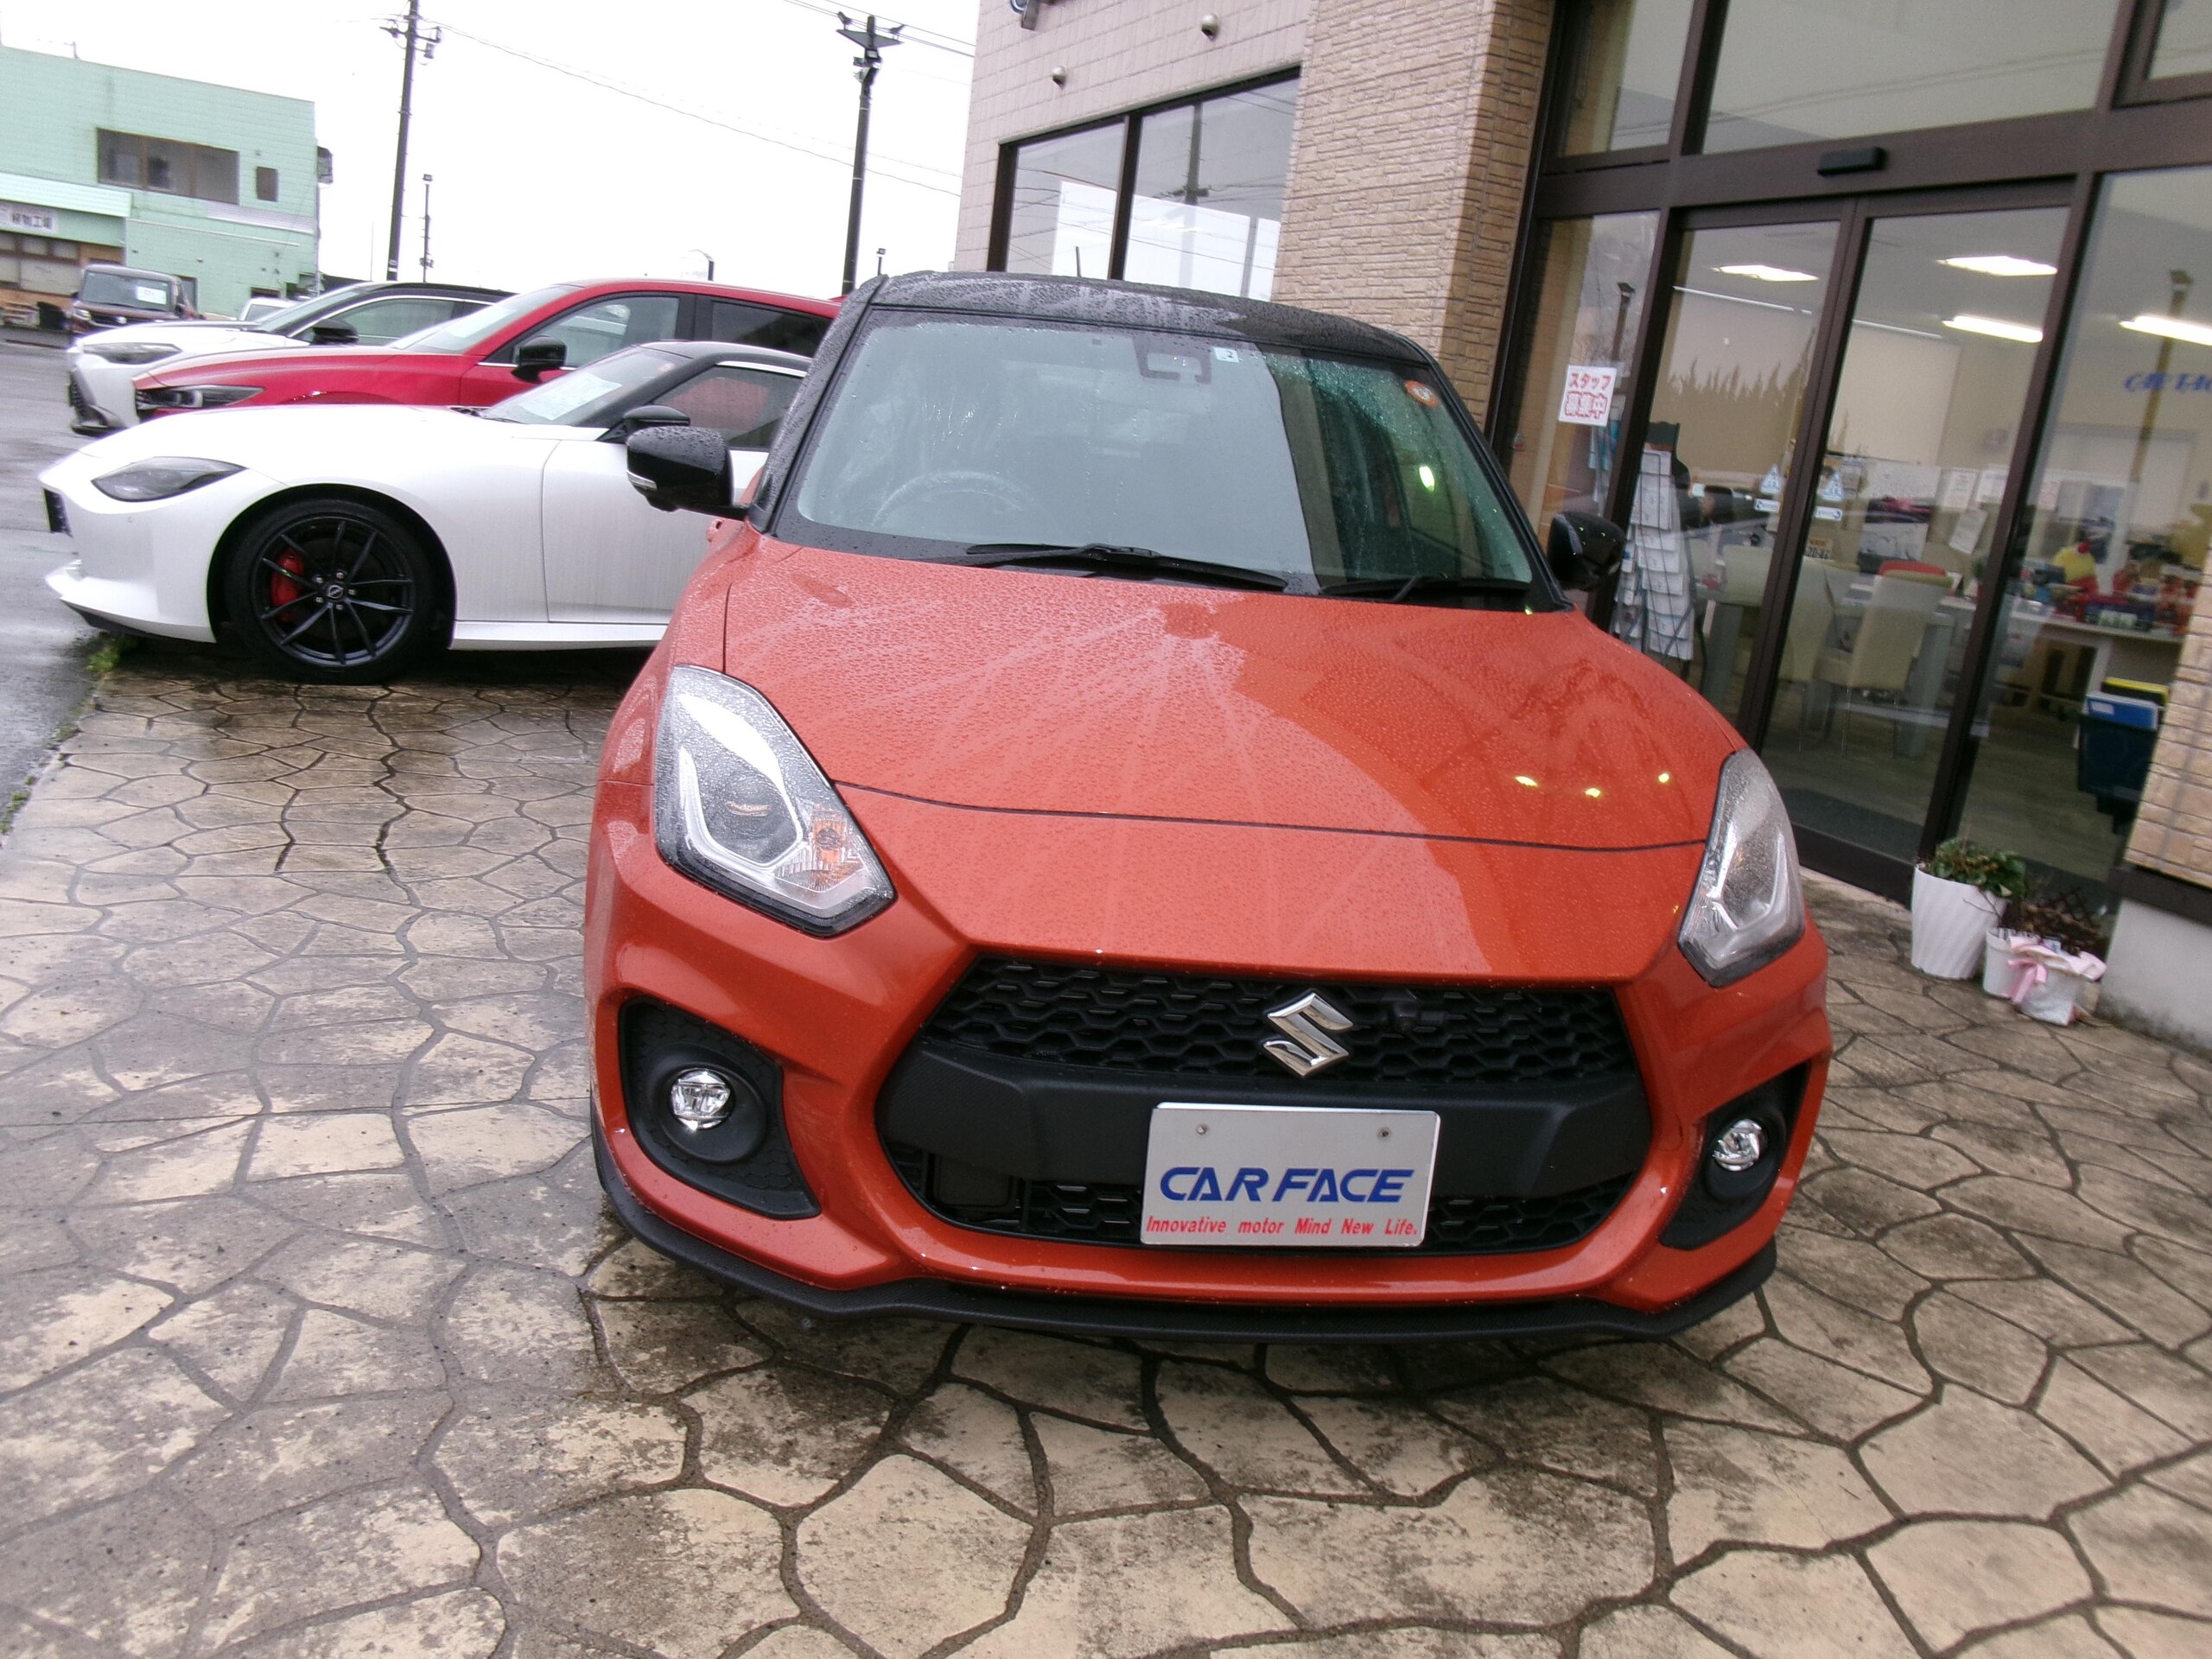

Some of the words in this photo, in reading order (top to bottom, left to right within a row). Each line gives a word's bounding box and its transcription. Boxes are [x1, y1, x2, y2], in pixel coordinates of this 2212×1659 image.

[1569, 372, 1611, 391] スタッフ
[1160, 1166, 1269, 1201] CAR
[1272, 1168, 1415, 1202] FACE
[1146, 1215, 1227, 1233] Innovative
[1237, 1217, 1286, 1234] motor
[1294, 1217, 1333, 1235] Mind
[1340, 1217, 1376, 1235] New
[1383, 1218, 1419, 1236] Life.
